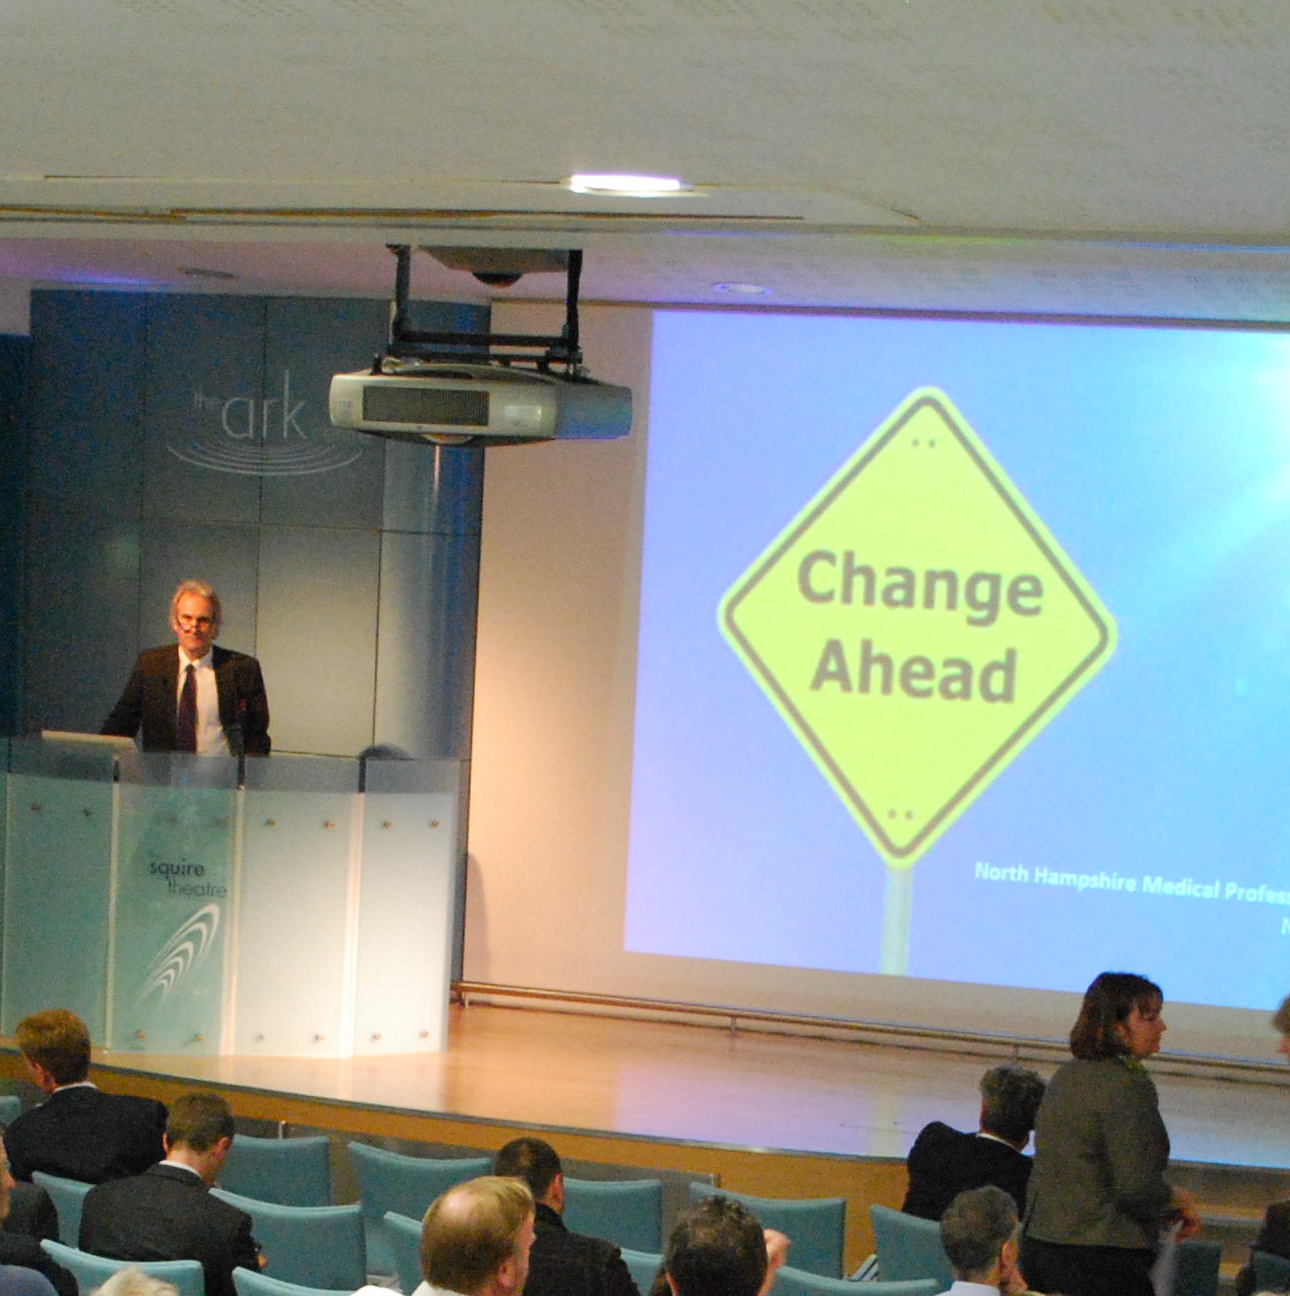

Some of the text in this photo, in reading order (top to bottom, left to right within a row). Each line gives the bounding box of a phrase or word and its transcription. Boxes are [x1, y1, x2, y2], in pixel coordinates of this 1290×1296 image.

[221, 370, 308, 439] ark
[797, 549, 1045, 628] Change
[809, 637, 1018, 705] Ahead
[149, 858, 205, 881] squire
[167, 879, 229, 898] theatre
[974, 861, 1030, 884] North
[1033, 866, 1138, 893] Hampshire
[1142, 875, 1220, 900] Medical
